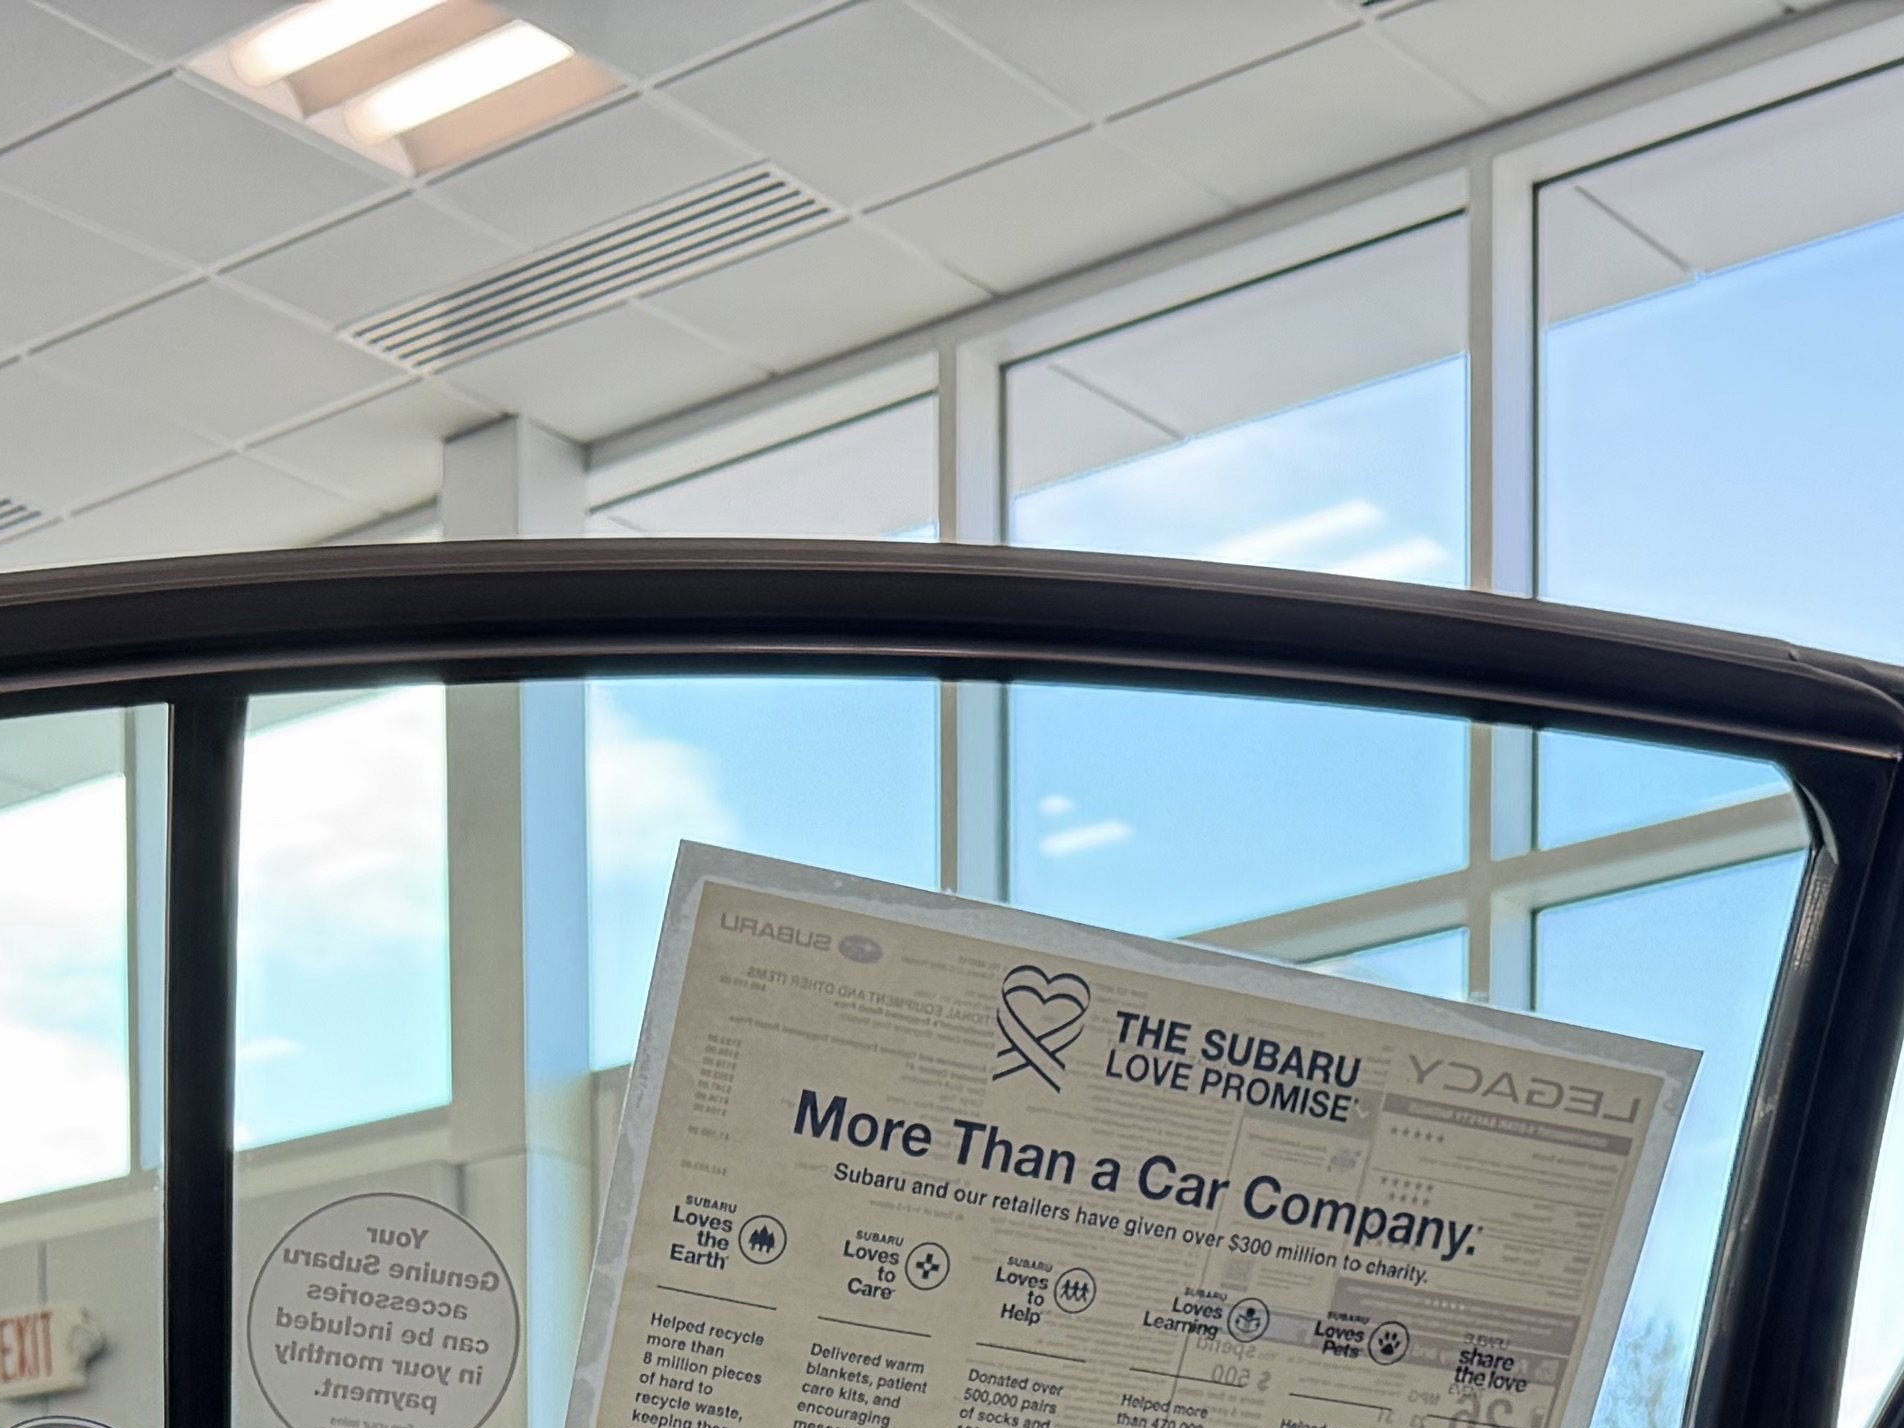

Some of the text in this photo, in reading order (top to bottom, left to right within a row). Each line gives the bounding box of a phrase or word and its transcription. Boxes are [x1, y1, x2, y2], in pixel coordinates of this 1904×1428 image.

[1116, 1010, 1361, 1088] THE SUBARU
[1105, 1048, 1193, 1091] LOVE
[793, 1089, 931, 1156] More
[953, 1118, 1075, 1184] Than
[1090, 1157, 1120, 1192] a
[1138, 1155, 1230, 1210] Car
[1243, 1175, 1474, 1261] Company.
[685, 1194, 737, 1213] SUBARU
[672, 1204, 732, 1232] Loves
[833, 1162, 1427, 1286] Subaru and our retailers have given over $300 million to charity.
[697, 1230, 729, 1250] the
[855, 1229, 904, 1246] SUBARU
[670, 1243, 725, 1269] Earth
[843, 1239, 899, 1265] Loves
[1007, 1256, 1053, 1272] SUBARU
[877, 1265, 895, 1282] to
[995, 1266, 1048, 1289] Loves
[847, 1277, 895, 1299] Care
[1027, 1290, 1044, 1306] to
[1000, 1303, 1040, 1326] Help
[1171, 1296, 1222, 1319] Loves
[650, 1312, 764, 1345] Helped recycle
[1142, 1310, 1221, 1341] Learning
[1314, 1320, 1364, 1342] Loves
[646, 1334, 724, 1357] more than
[810, 1342, 924, 1373] Delivered warm
[1321, 1339, 1362, 1357] Pets
[642, 1351, 761, 1384] 8 million pieces
[1458, 1347, 1514, 1371] share
[639, 1371, 712, 1395] of hard to
[806, 1361, 927, 1393] blankets, patient
[968, 1368, 1064, 1395] Donated over
[1454, 1365, 1529, 1392] the love
[635, 1391, 742, 1421] recycle waste,
[801, 1382, 901, 1408] care kits, and
[963, 1387, 1056, 1414] 500,000 pairs
[1120, 1393, 1208, 1419] Helped more
[796, 1401, 890, 1428] encouraging
[959, 1406, 974, 1419] of
[977, 1411, 1018, 1427] socks
[1116, 1412, 1147, 1428] than
